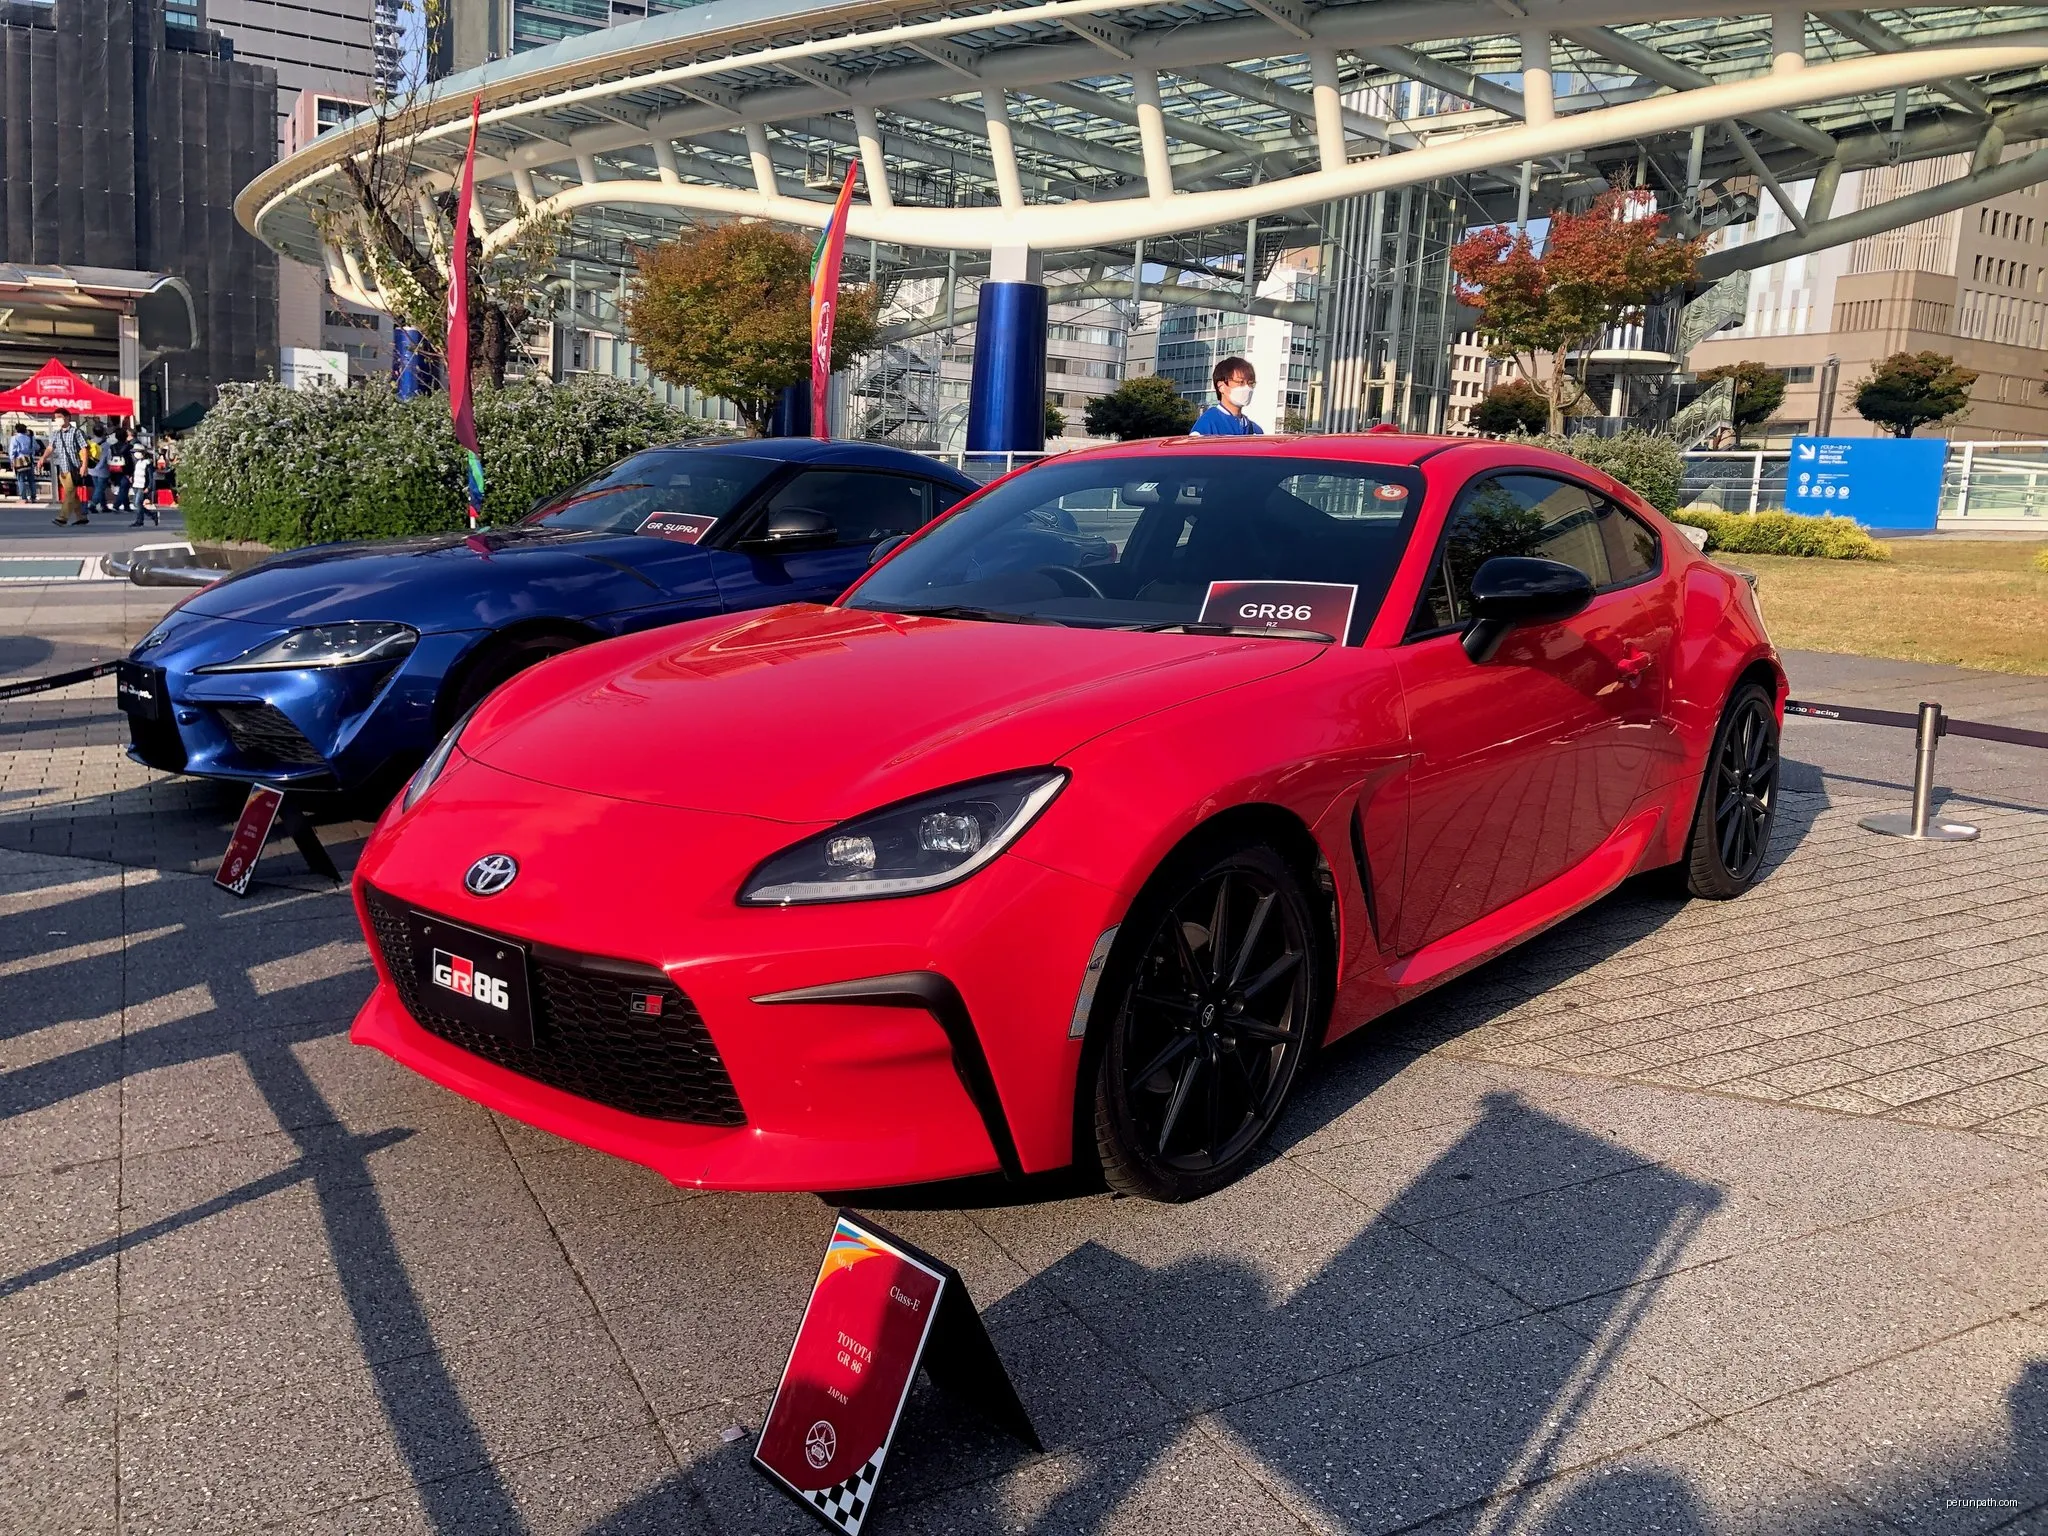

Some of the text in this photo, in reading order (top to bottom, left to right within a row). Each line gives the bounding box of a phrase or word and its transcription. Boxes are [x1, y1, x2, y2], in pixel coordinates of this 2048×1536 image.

[21, 396, 92, 410] LE GARAGE
[647, 522, 699, 534] GR SUPRA
[1239, 603, 1312, 621] GR86
[1784, 705, 1840, 718] AZOO Racing
[632, 1001, 662, 1013] GR
[889, 1285, 921, 1312] Class-E
[837, 1330, 872, 1363] TOYOTA
[837, 1350, 863, 1374] GR 86
[827, 1385, 849, 1405] JAPAN
